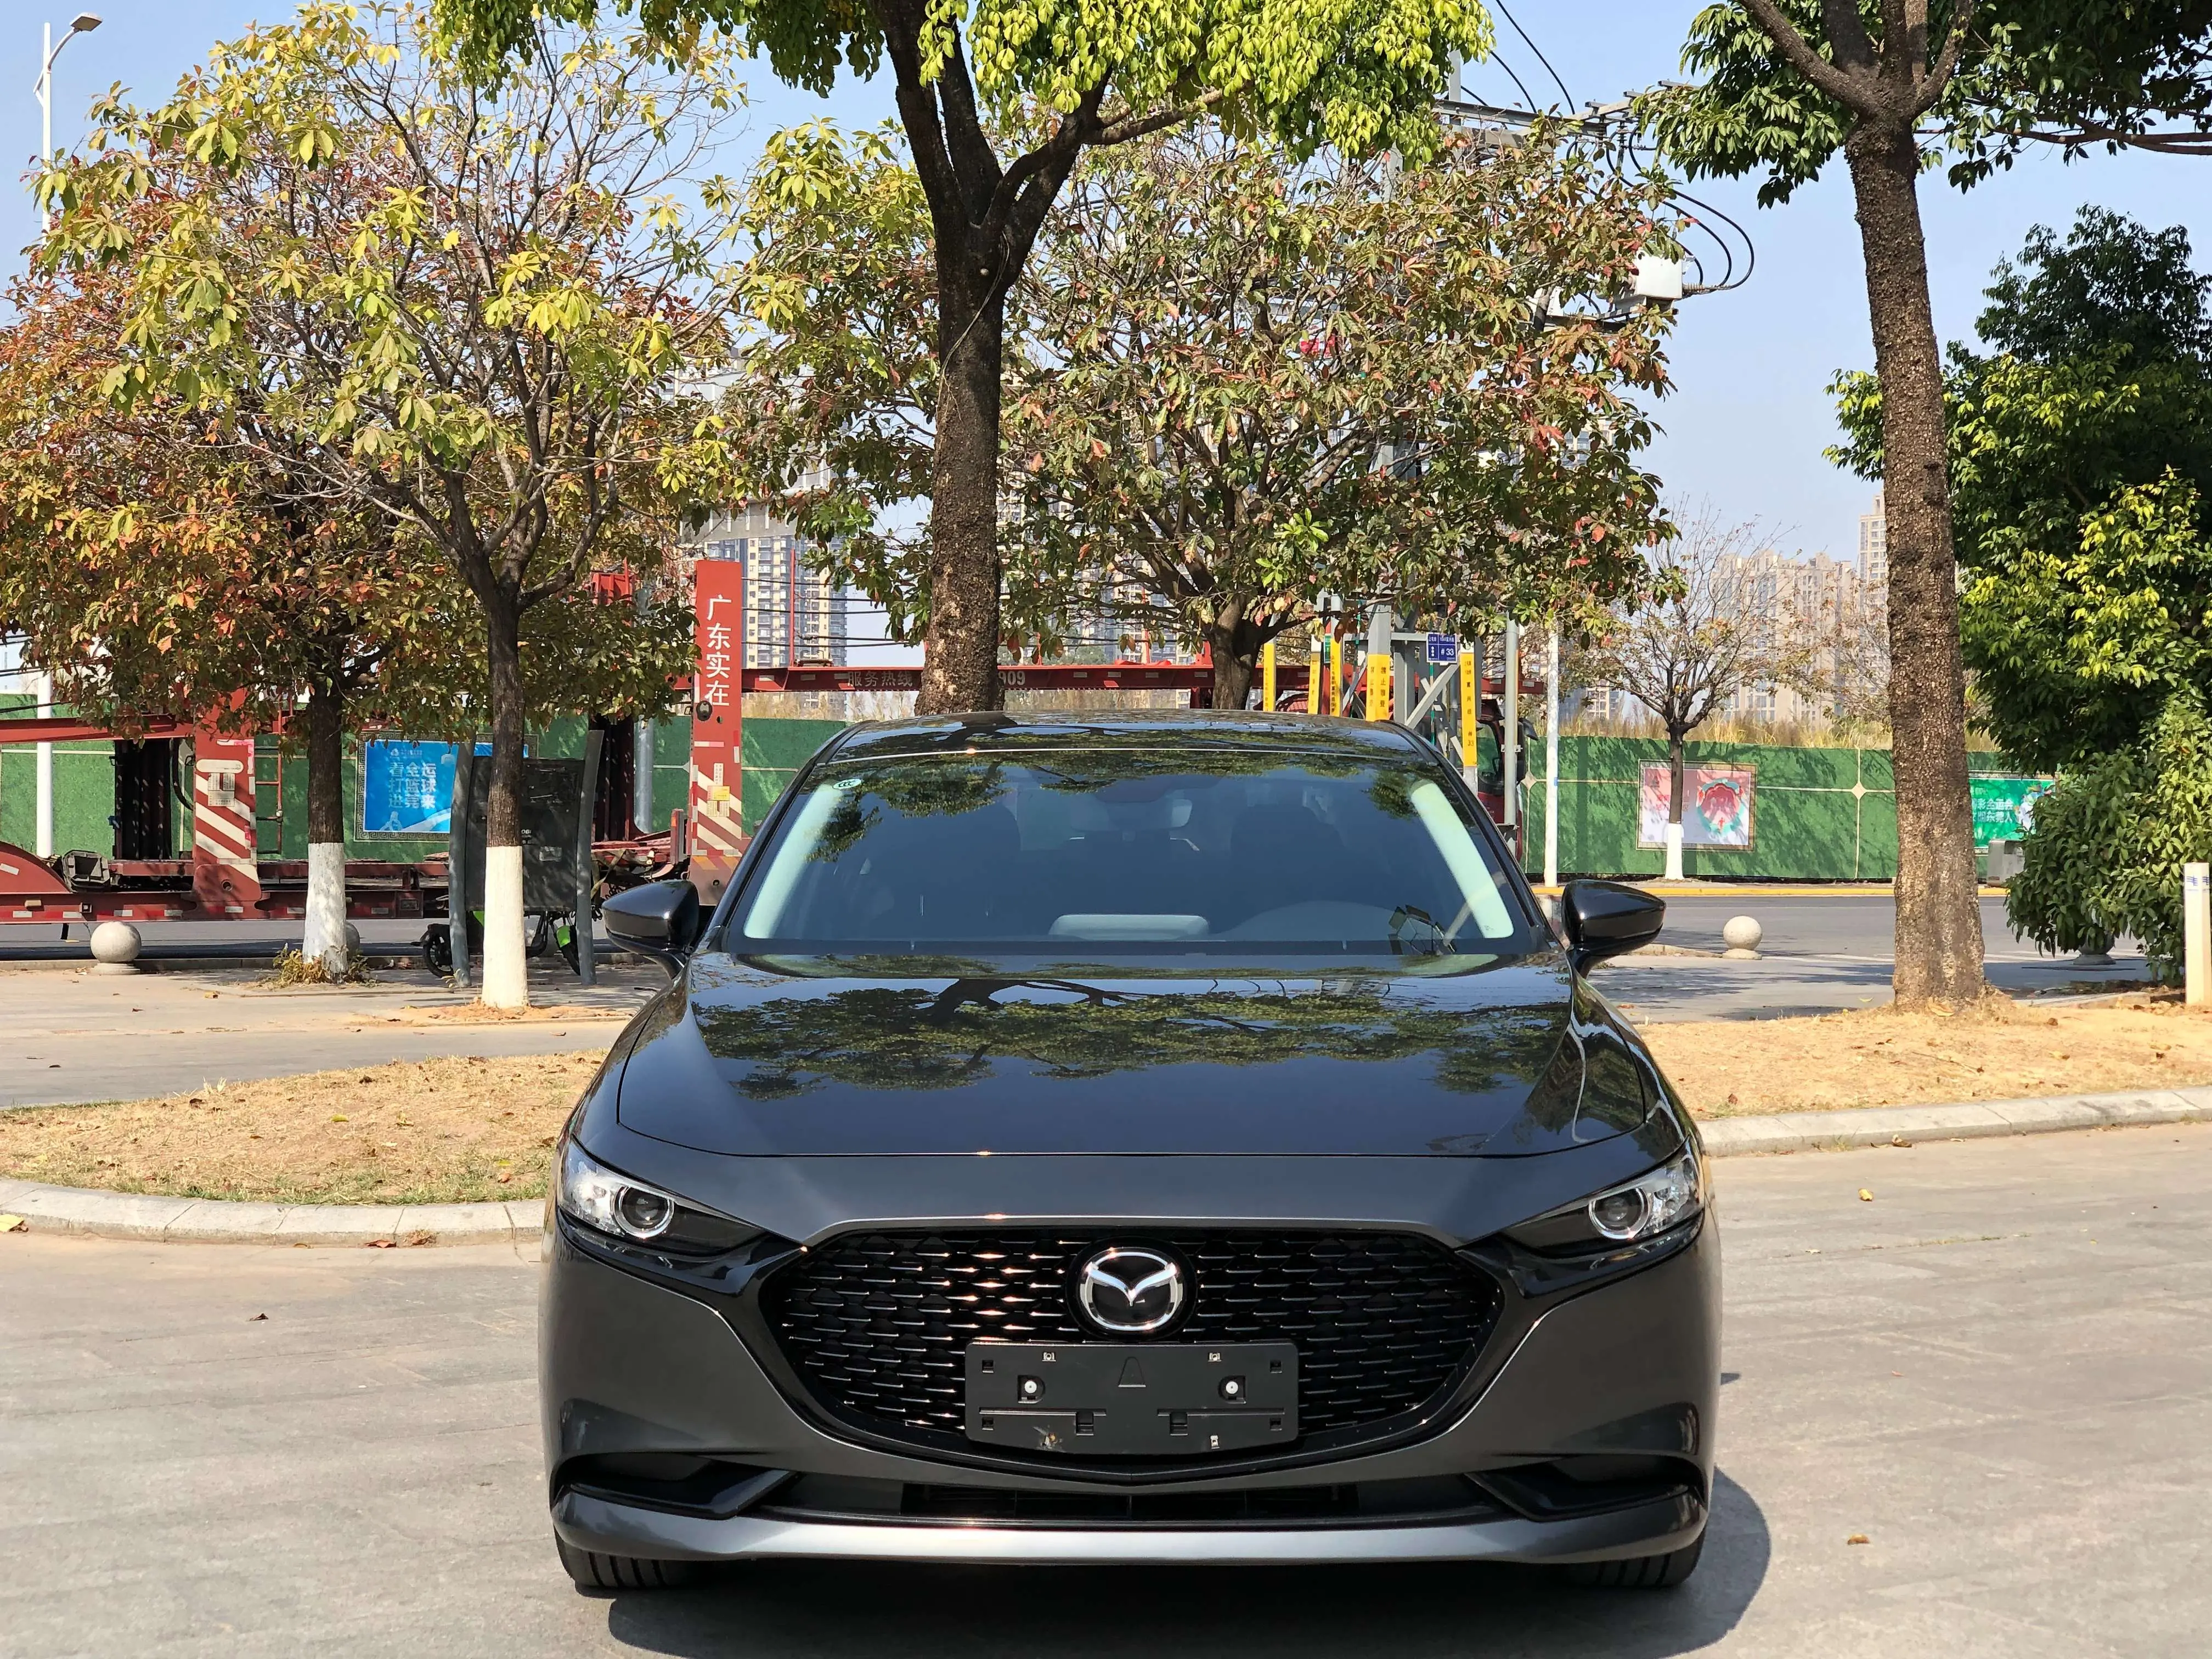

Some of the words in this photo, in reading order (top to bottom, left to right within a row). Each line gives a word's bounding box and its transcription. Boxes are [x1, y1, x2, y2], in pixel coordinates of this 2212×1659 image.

[704, 594, 732, 706] 广东实在
[849, 671, 913, 686] 服务热线
